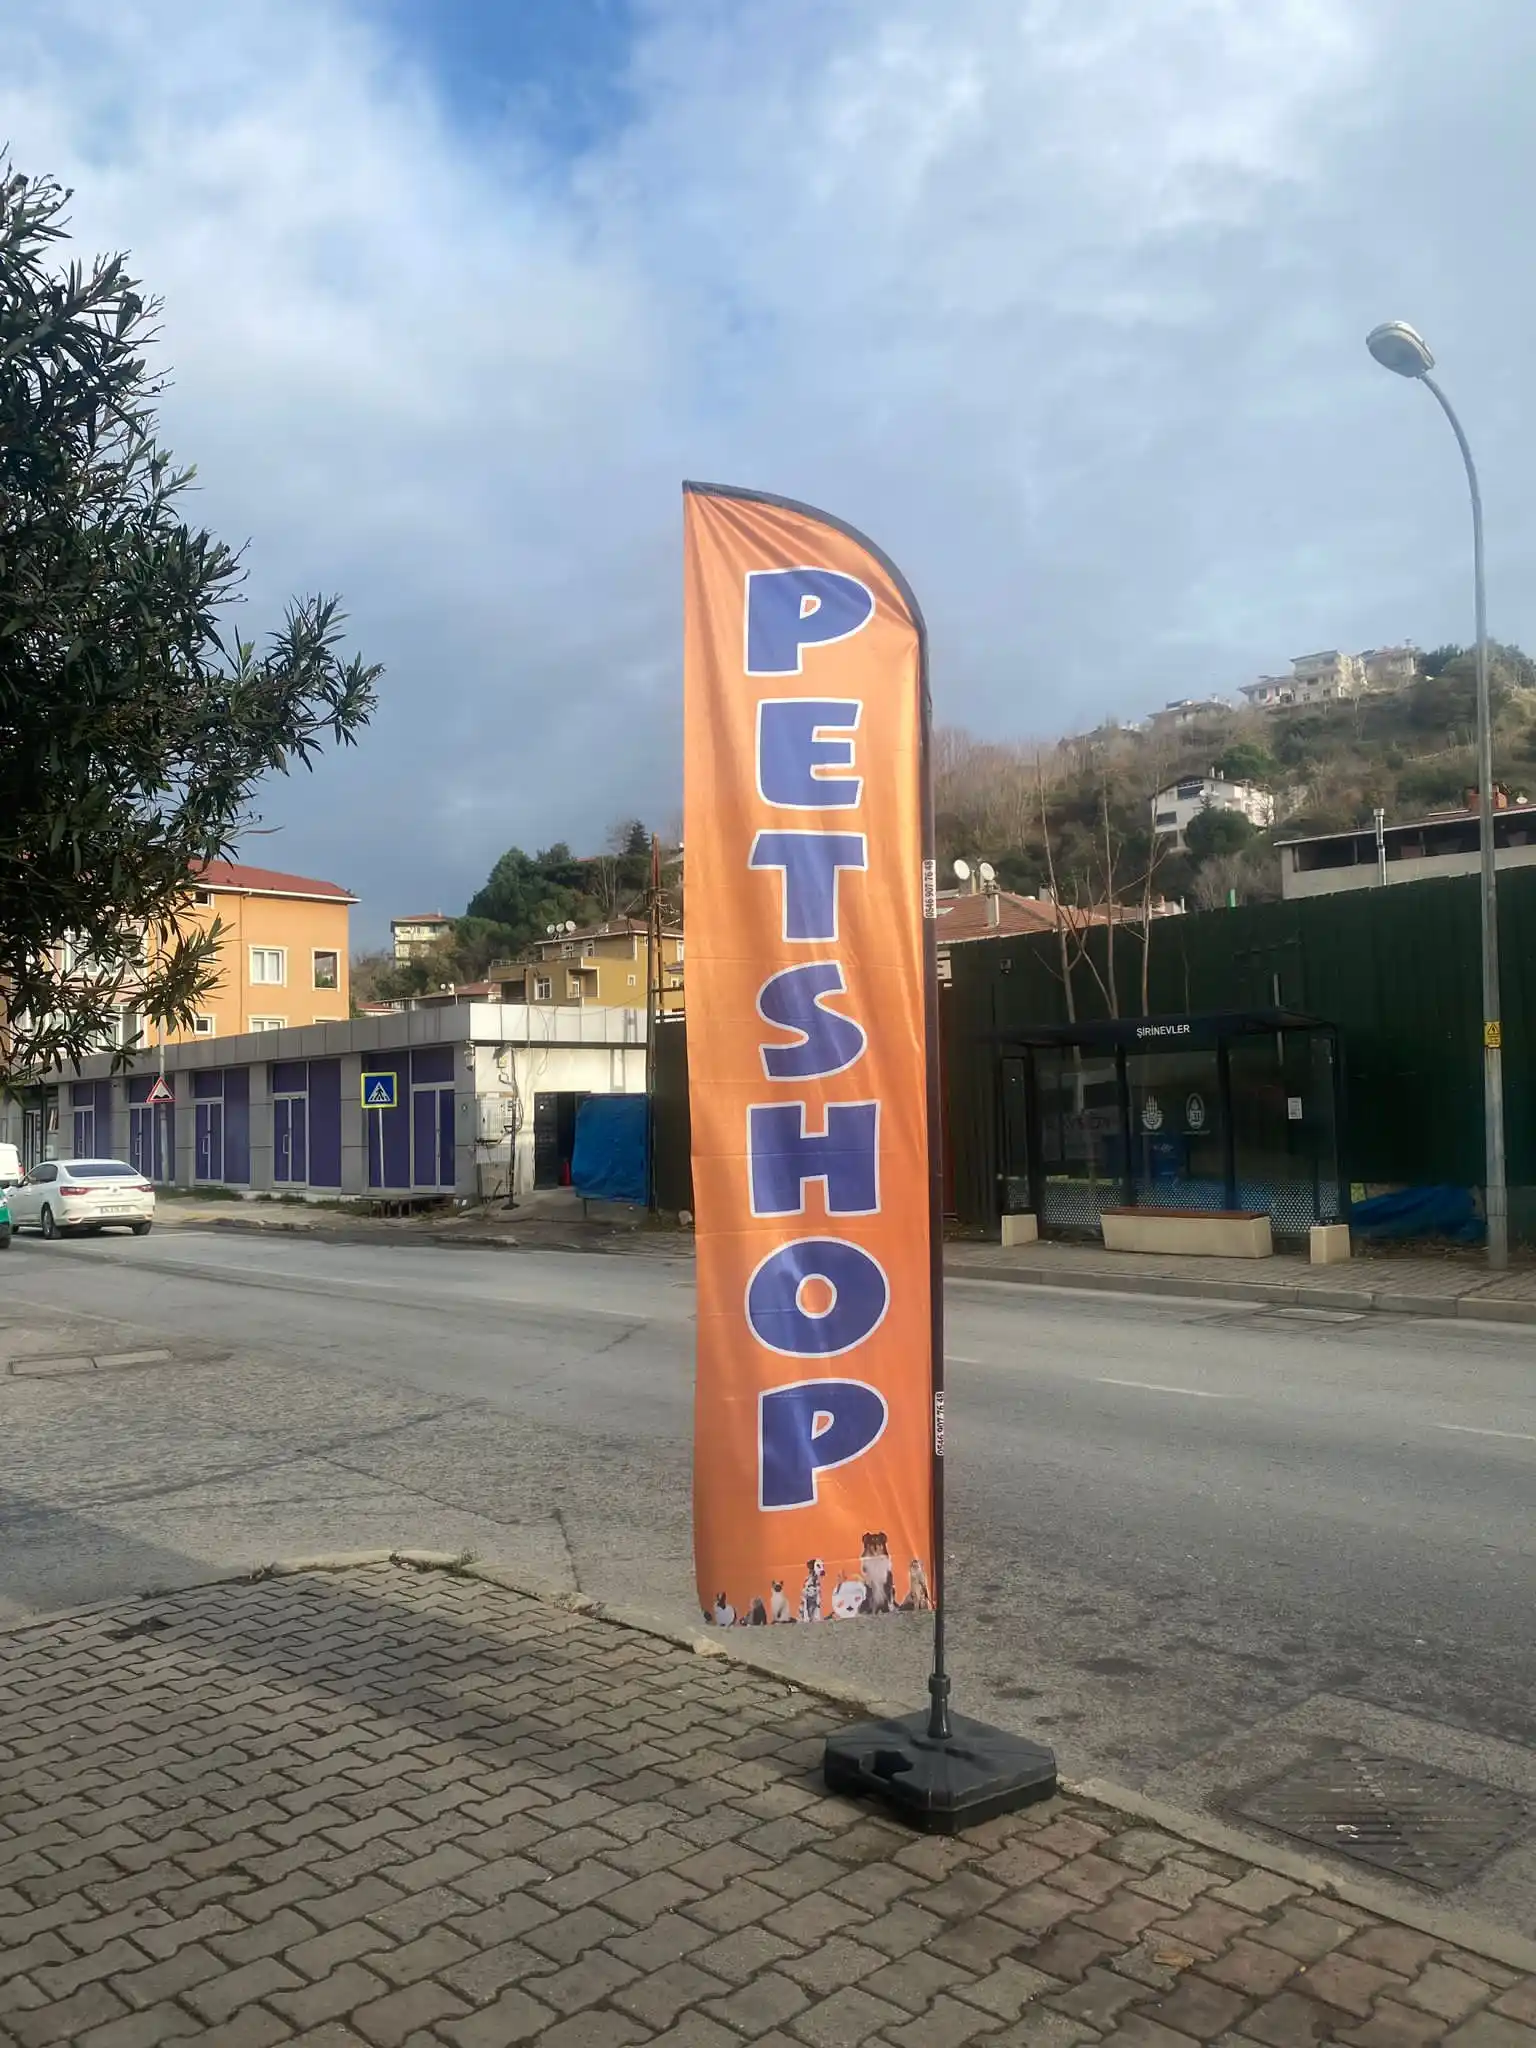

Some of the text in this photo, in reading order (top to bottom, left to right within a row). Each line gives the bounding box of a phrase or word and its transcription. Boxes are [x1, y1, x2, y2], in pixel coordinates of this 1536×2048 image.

[924, 860, 935, 917] 0546 907 76 48
[1136, 1024, 1191, 1039] ŞİRİNEVLER
[936, 1392, 944, 1403] 48
[936, 1417, 944, 1433] 907
